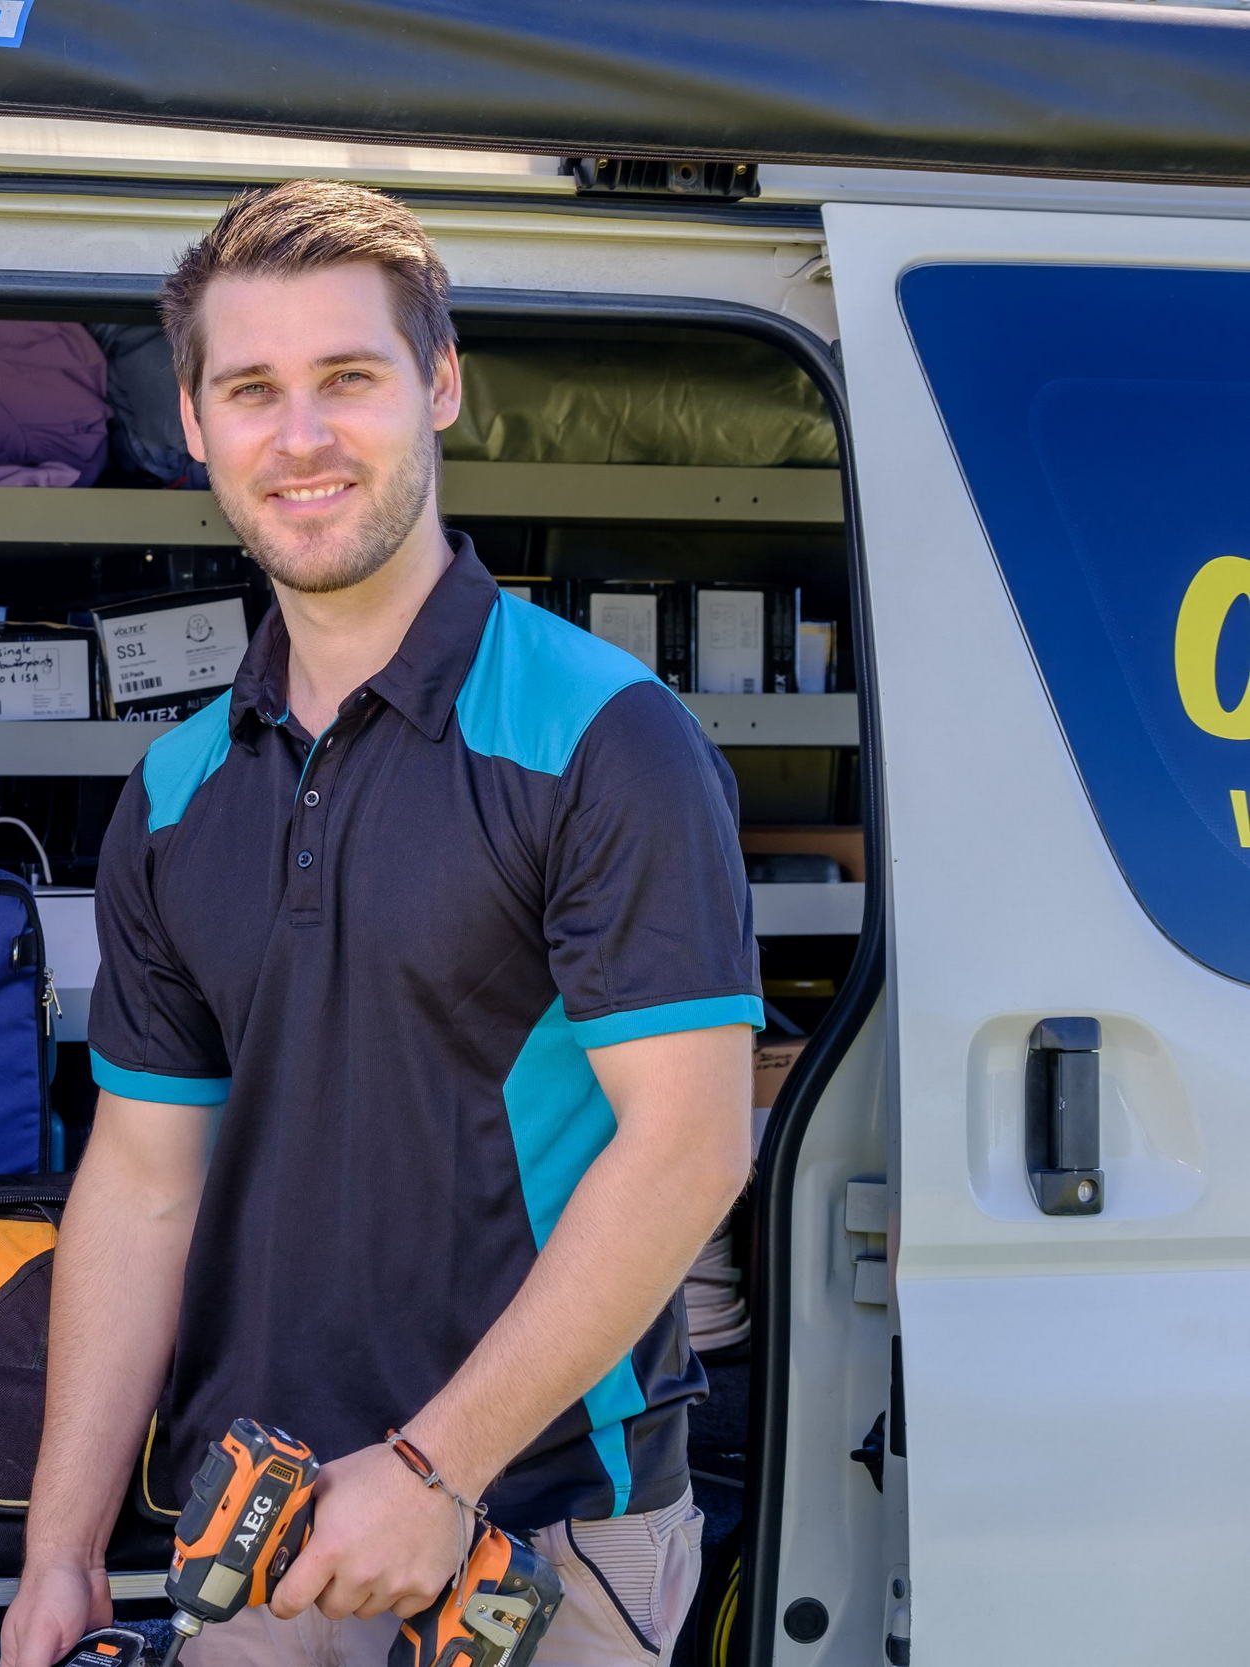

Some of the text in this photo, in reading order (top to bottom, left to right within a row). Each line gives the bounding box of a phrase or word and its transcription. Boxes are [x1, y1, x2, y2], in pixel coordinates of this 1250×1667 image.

[113, 623, 147, 636] VOLTEX
[116, 642, 146, 660] SS1
[235, 1495, 272, 1552] AEG
